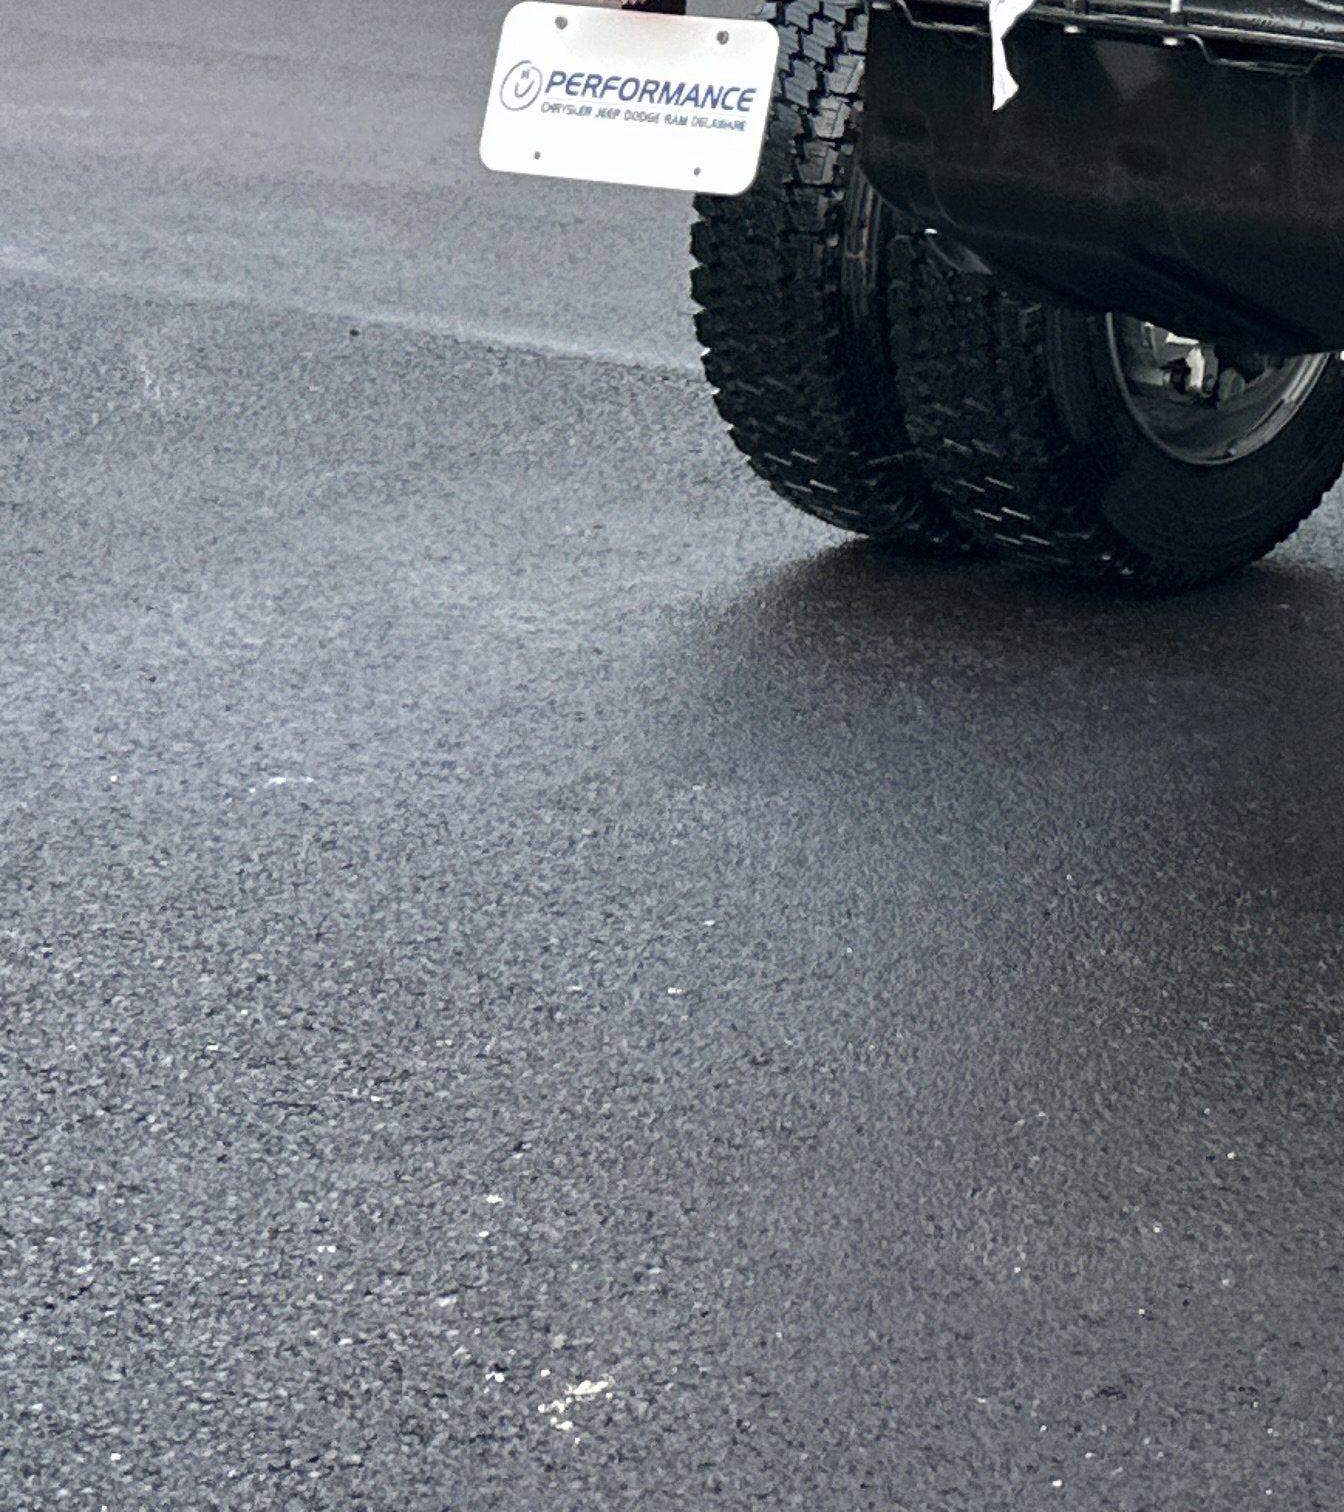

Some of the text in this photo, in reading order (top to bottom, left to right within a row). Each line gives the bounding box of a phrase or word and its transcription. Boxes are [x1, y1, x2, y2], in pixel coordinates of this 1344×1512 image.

[544, 70, 758, 112] PERFORMANCE
[540, 101, 748, 132] CHRYSLER JEEP DODGE RAM DELAWARE
